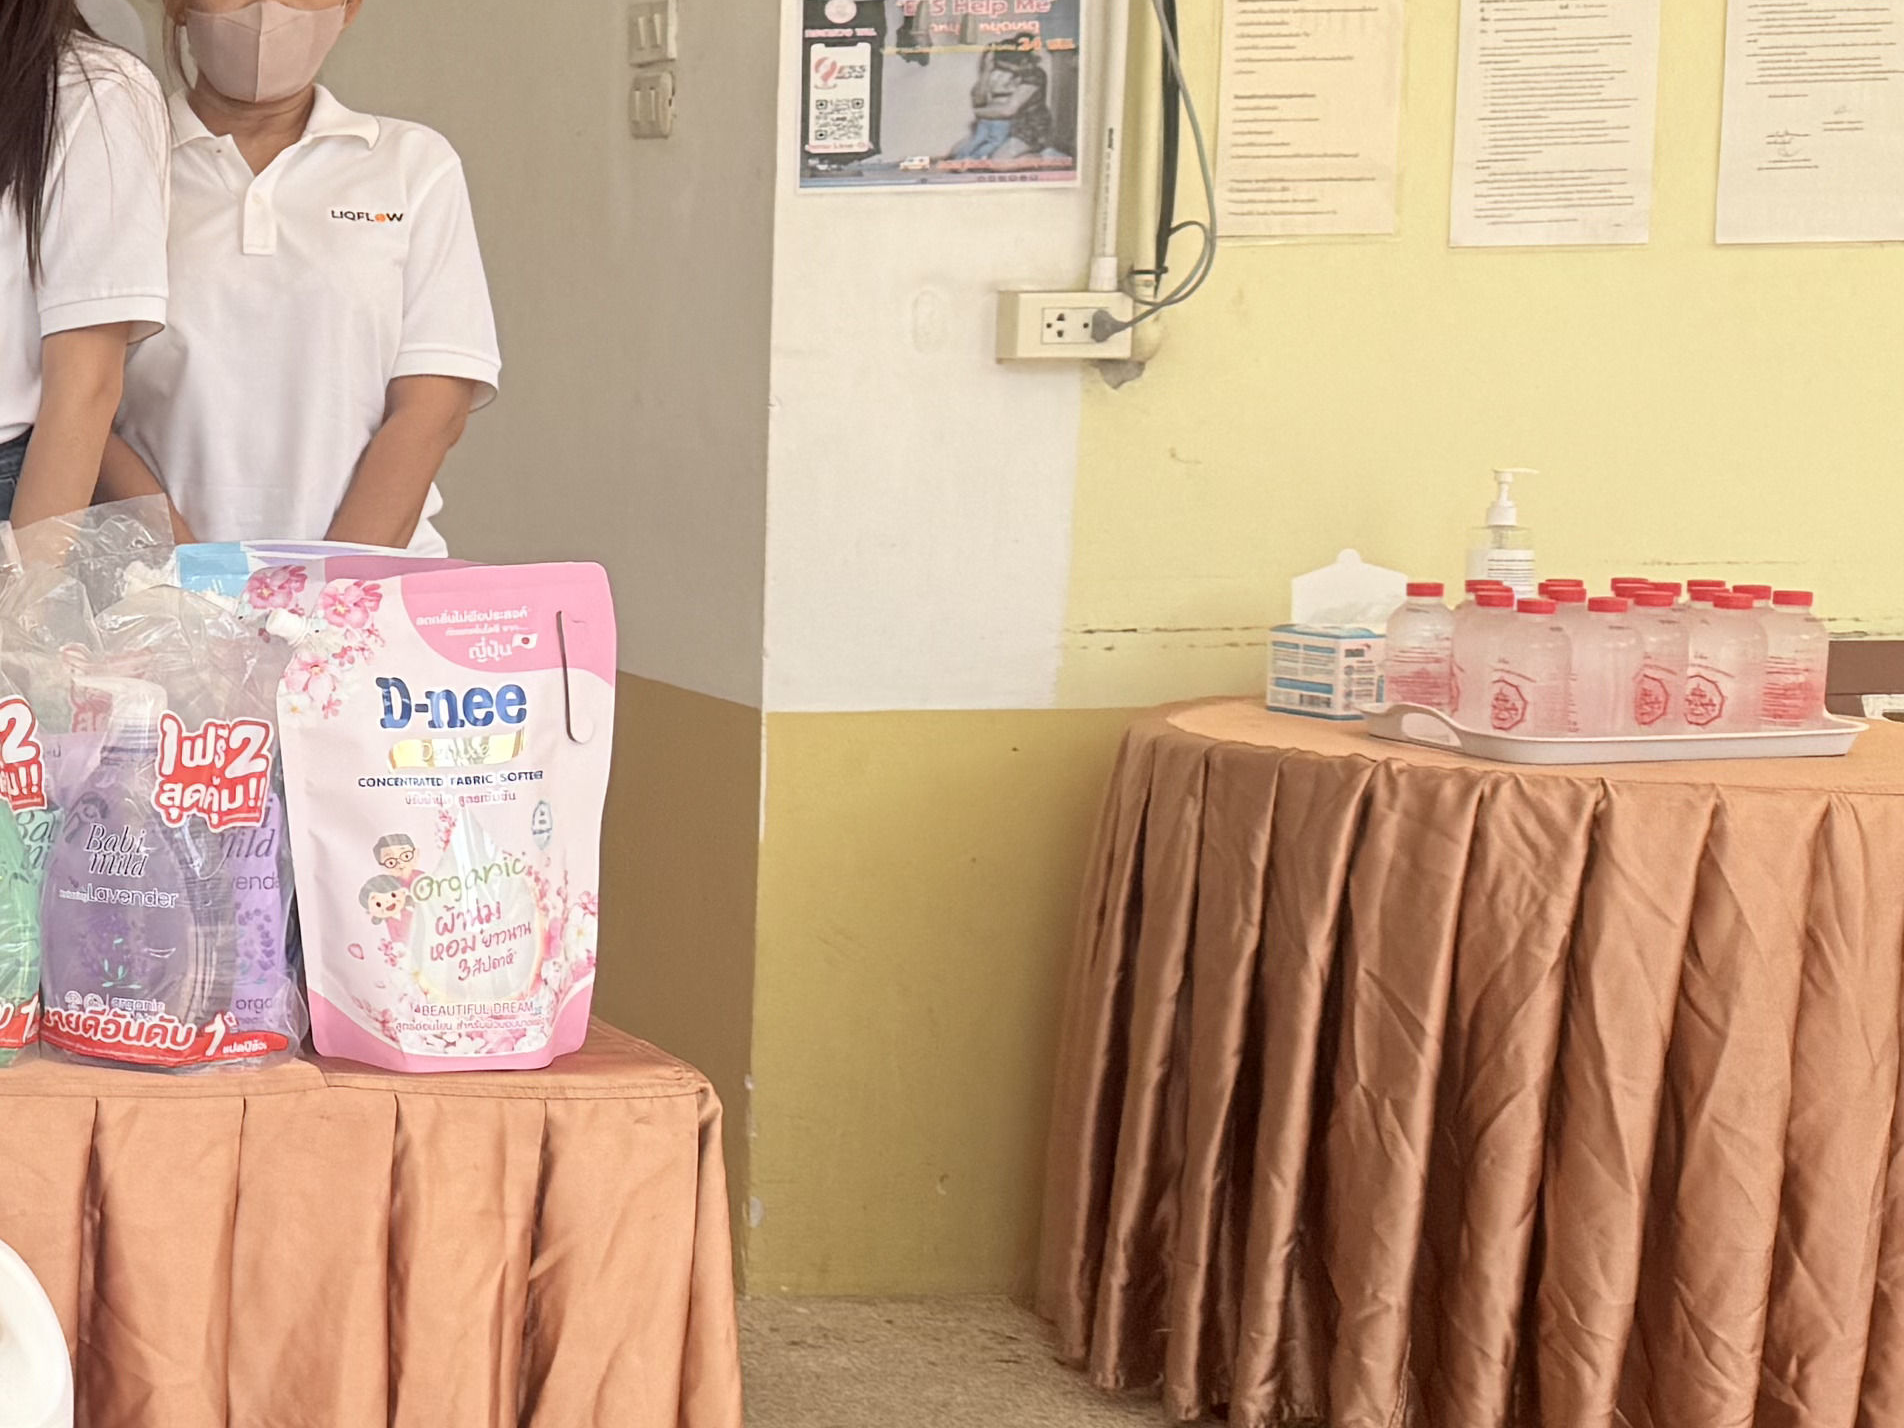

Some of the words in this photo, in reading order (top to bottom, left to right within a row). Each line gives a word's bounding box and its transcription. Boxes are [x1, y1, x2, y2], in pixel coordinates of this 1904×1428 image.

[331, 209, 404, 223] LIQFLOW
[374, 675, 528, 730] D-nee
[358, 775, 445, 789] CONCENTRATED
[409, 853, 528, 904] Organic
[86, 882, 180, 909] Lavender
